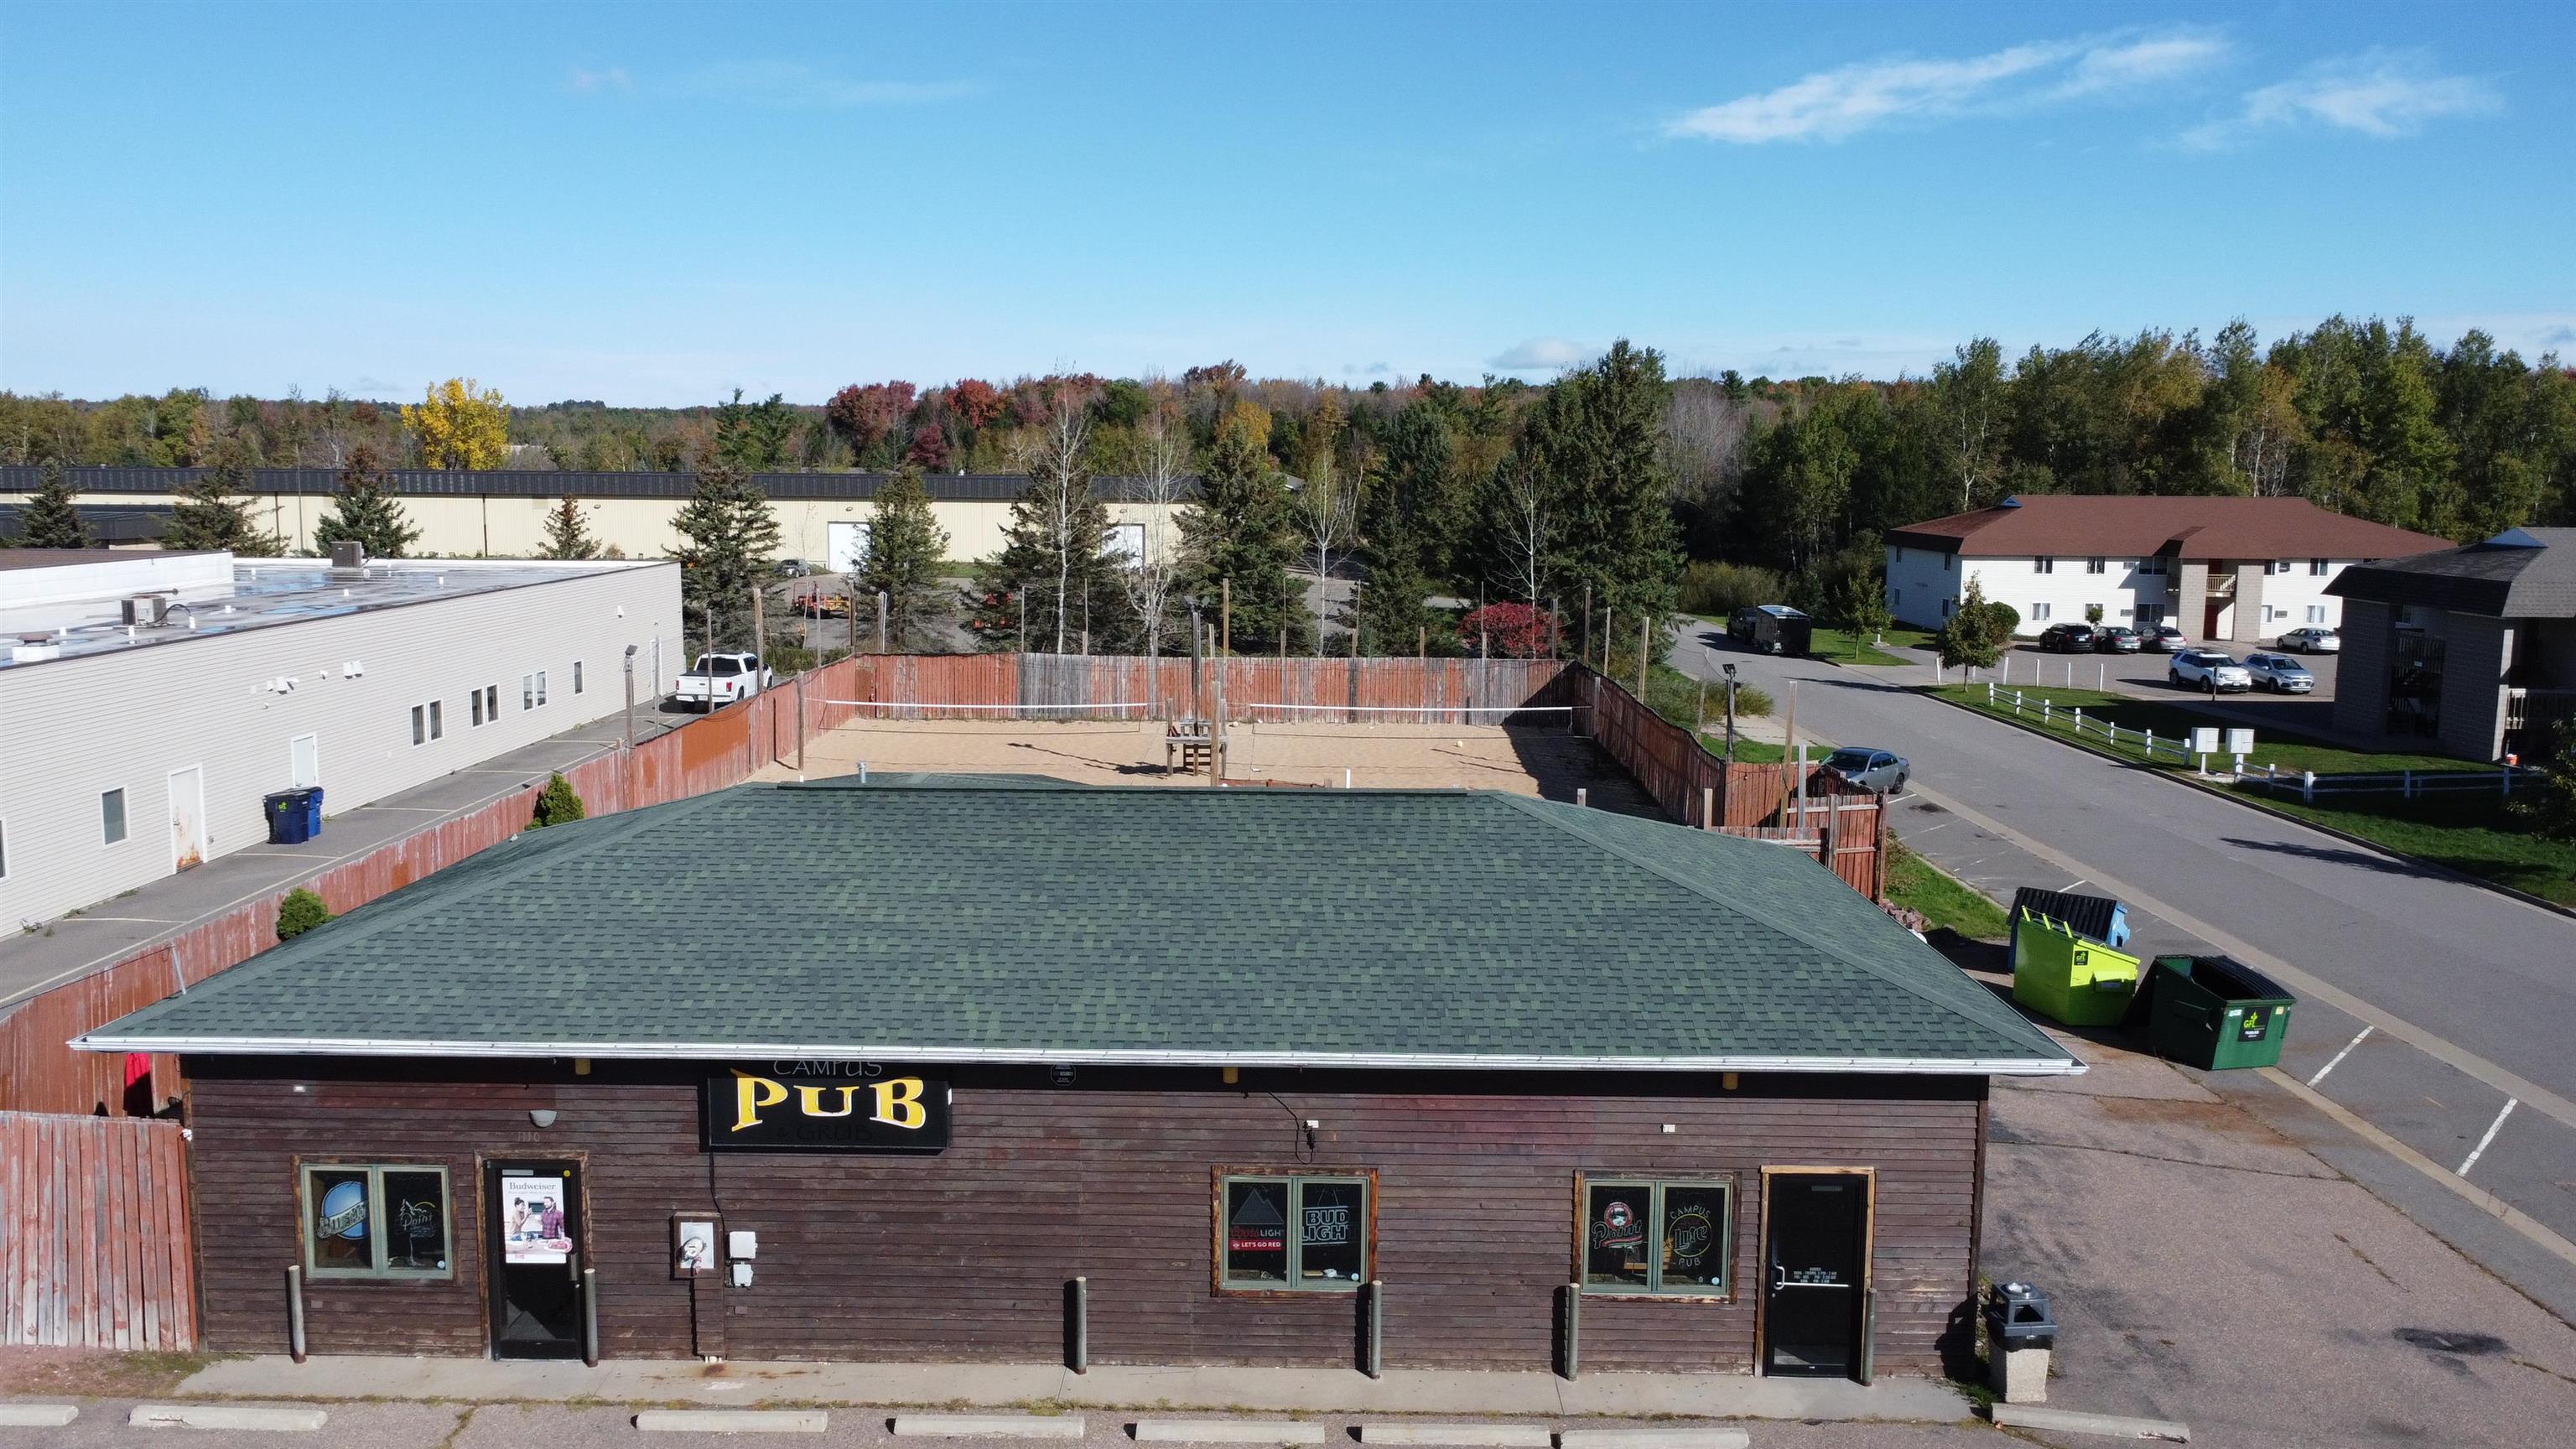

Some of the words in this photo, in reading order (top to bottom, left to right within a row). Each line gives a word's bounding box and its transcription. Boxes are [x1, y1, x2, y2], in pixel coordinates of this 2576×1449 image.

[2243, 1020, 2255, 1028] GFL
[773, 1060, 882, 1077] CAMPUS
[730, 1067, 927, 1132] PUB
[796, 1124, 873, 1141] GRUB
[509, 1182, 556, 1191] Budweiser
[1306, 1209, 1348, 1226] BUD
[1670, 1205, 1711, 1219] CAMPUS
[1678, 1258, 1701, 1268] PUB
